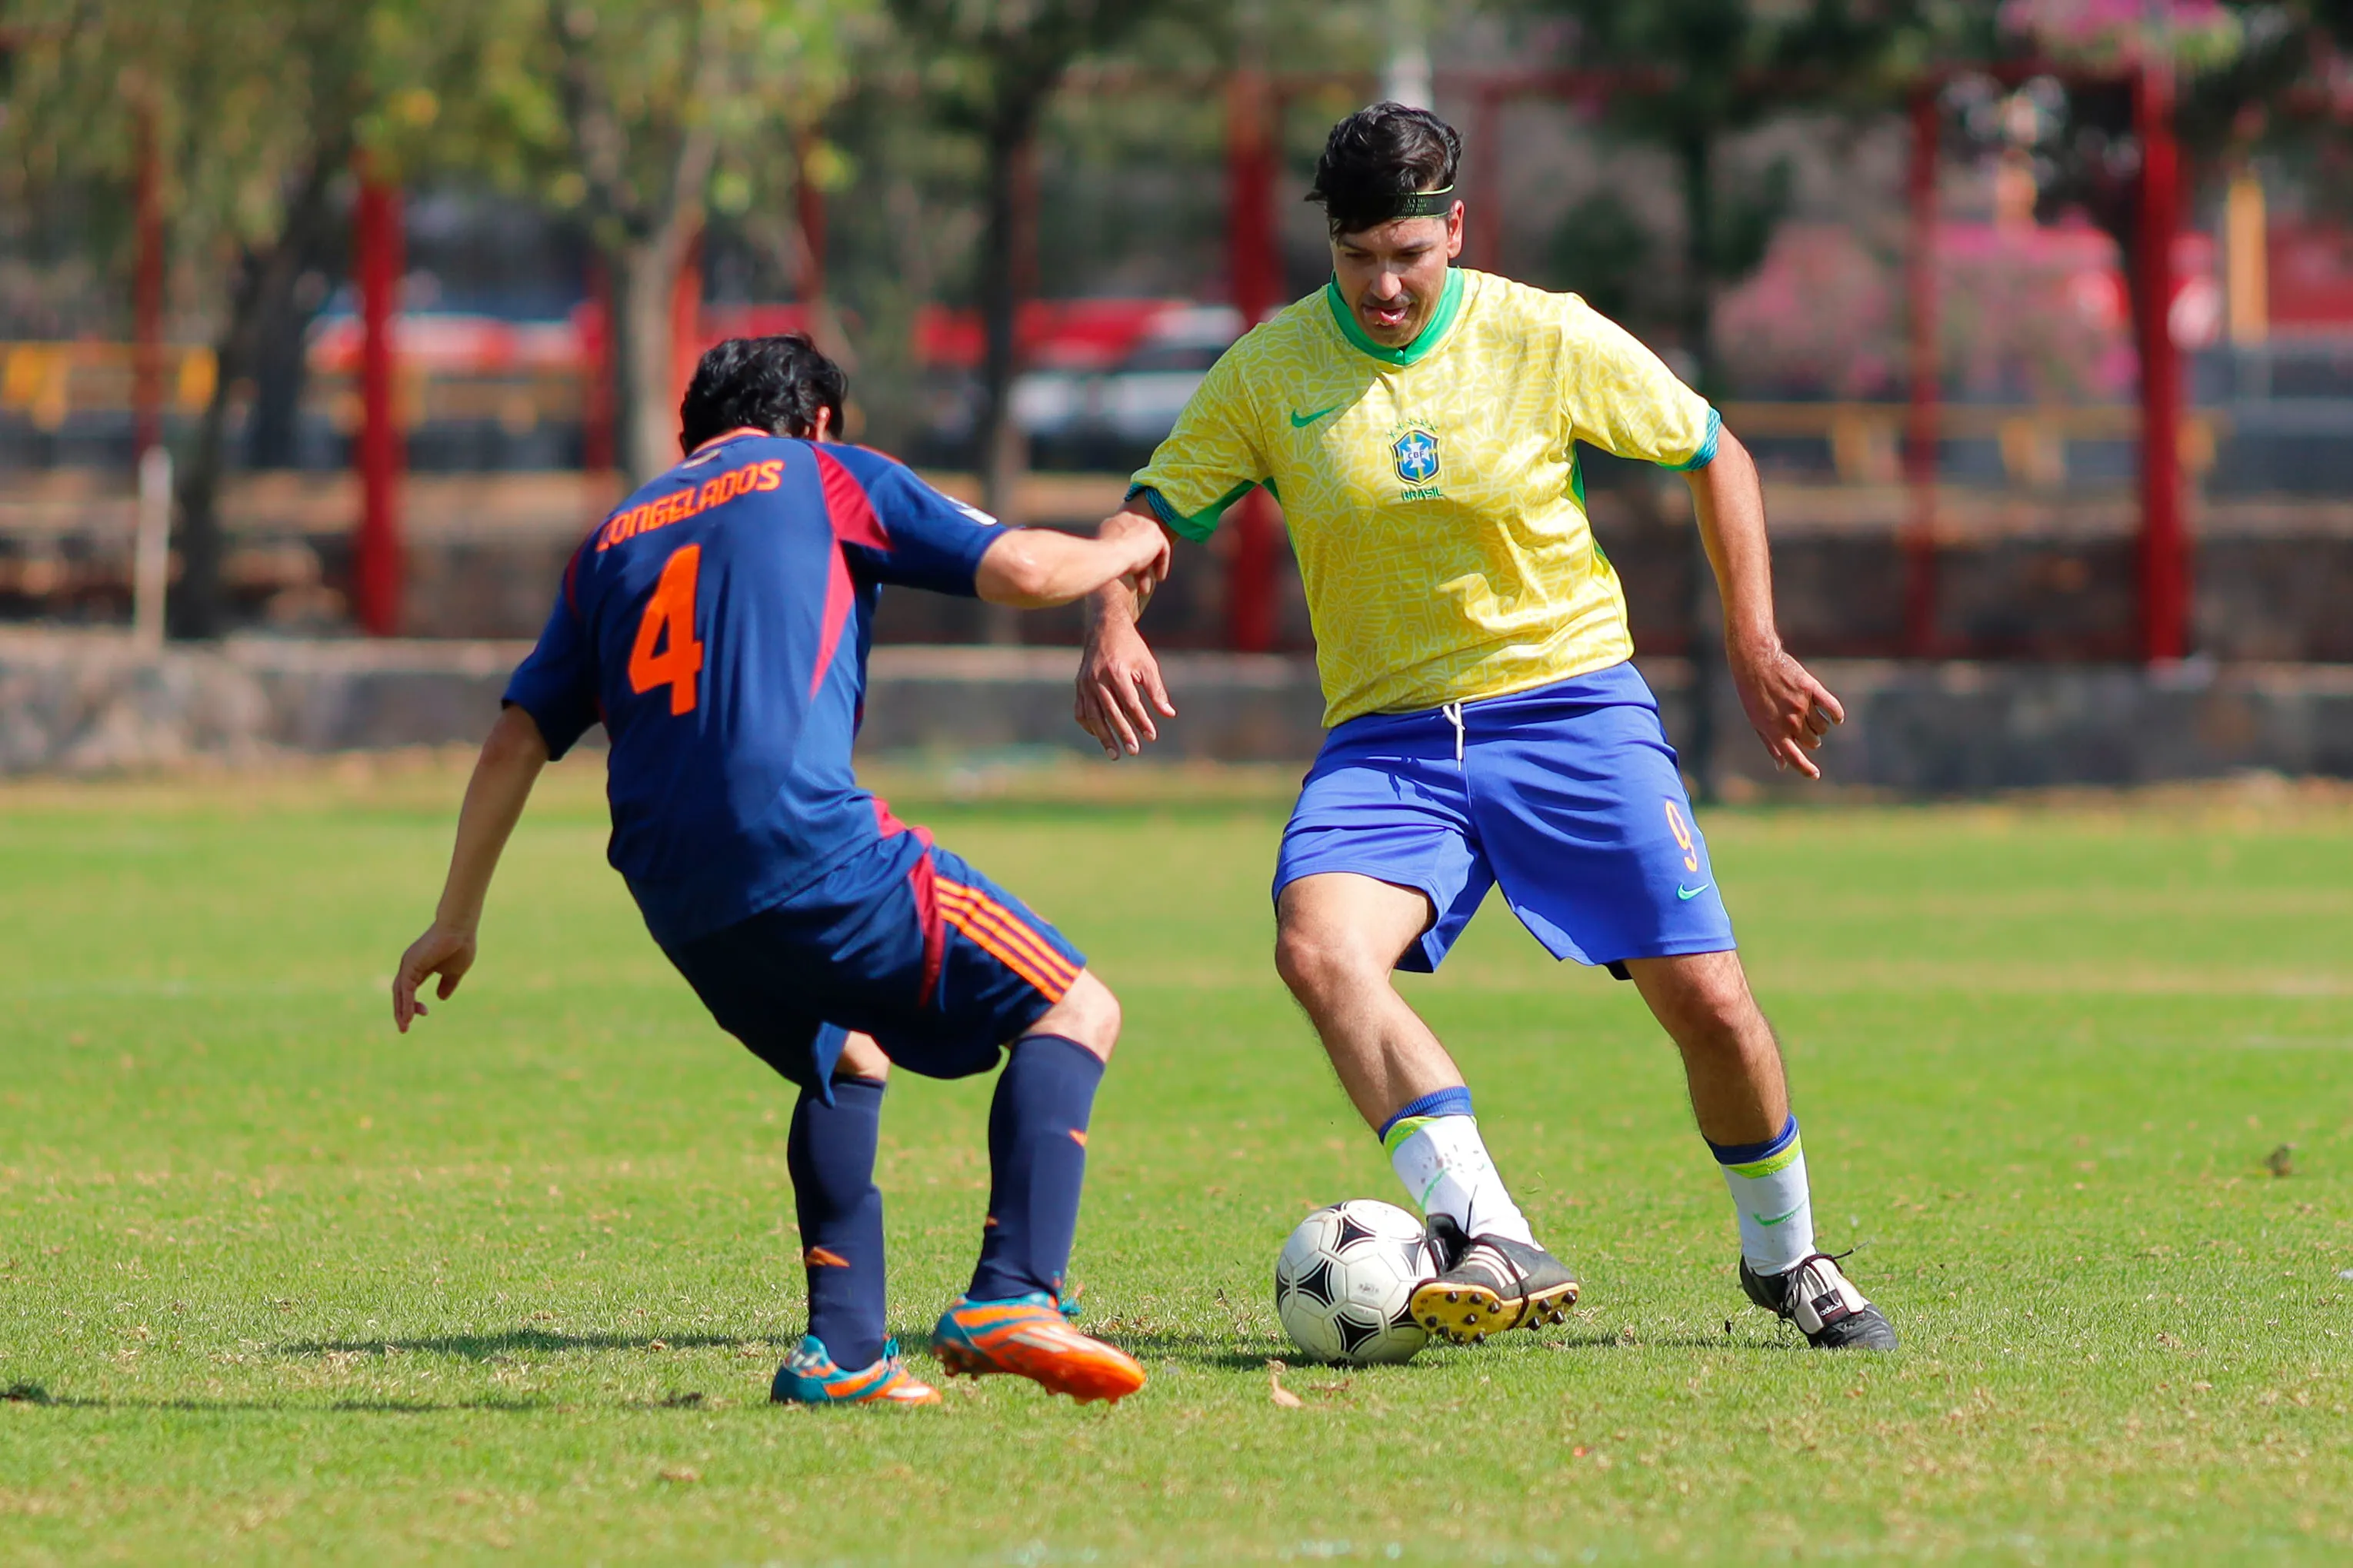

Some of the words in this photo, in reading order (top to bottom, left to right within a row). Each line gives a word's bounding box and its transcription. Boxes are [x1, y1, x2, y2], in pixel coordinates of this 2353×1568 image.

[1408, 451, 1424, 460] CBF
[1401, 486, 1444, 501] BRASIL
[628, 542, 704, 717] 4
[1665, 799, 1698, 873] 9
